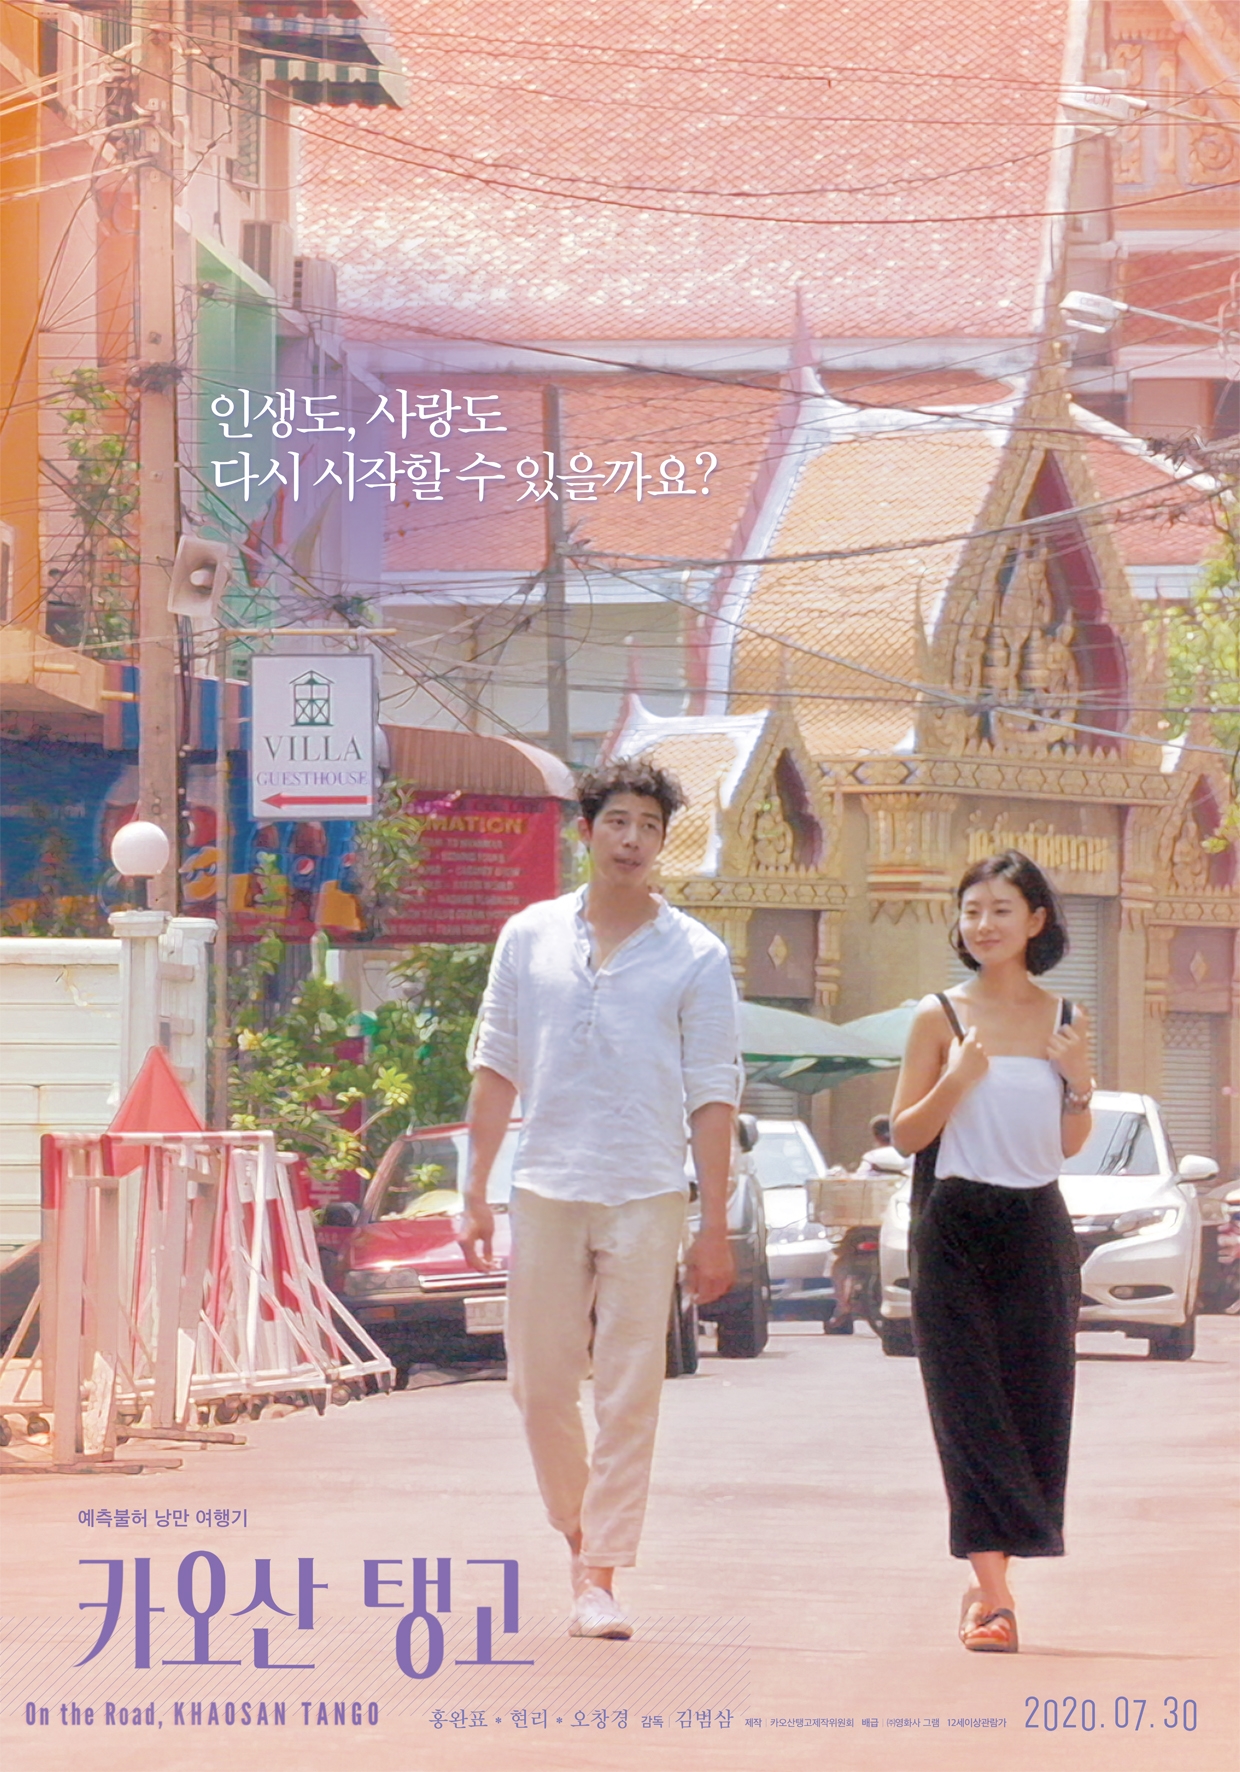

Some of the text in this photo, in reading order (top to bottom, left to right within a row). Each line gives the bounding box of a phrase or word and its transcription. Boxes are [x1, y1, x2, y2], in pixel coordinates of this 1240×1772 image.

[264, 735, 363, 762] VILLA
[256, 771, 368, 786] GUESTHOUSE
[425, 815, 524, 834] MATION
